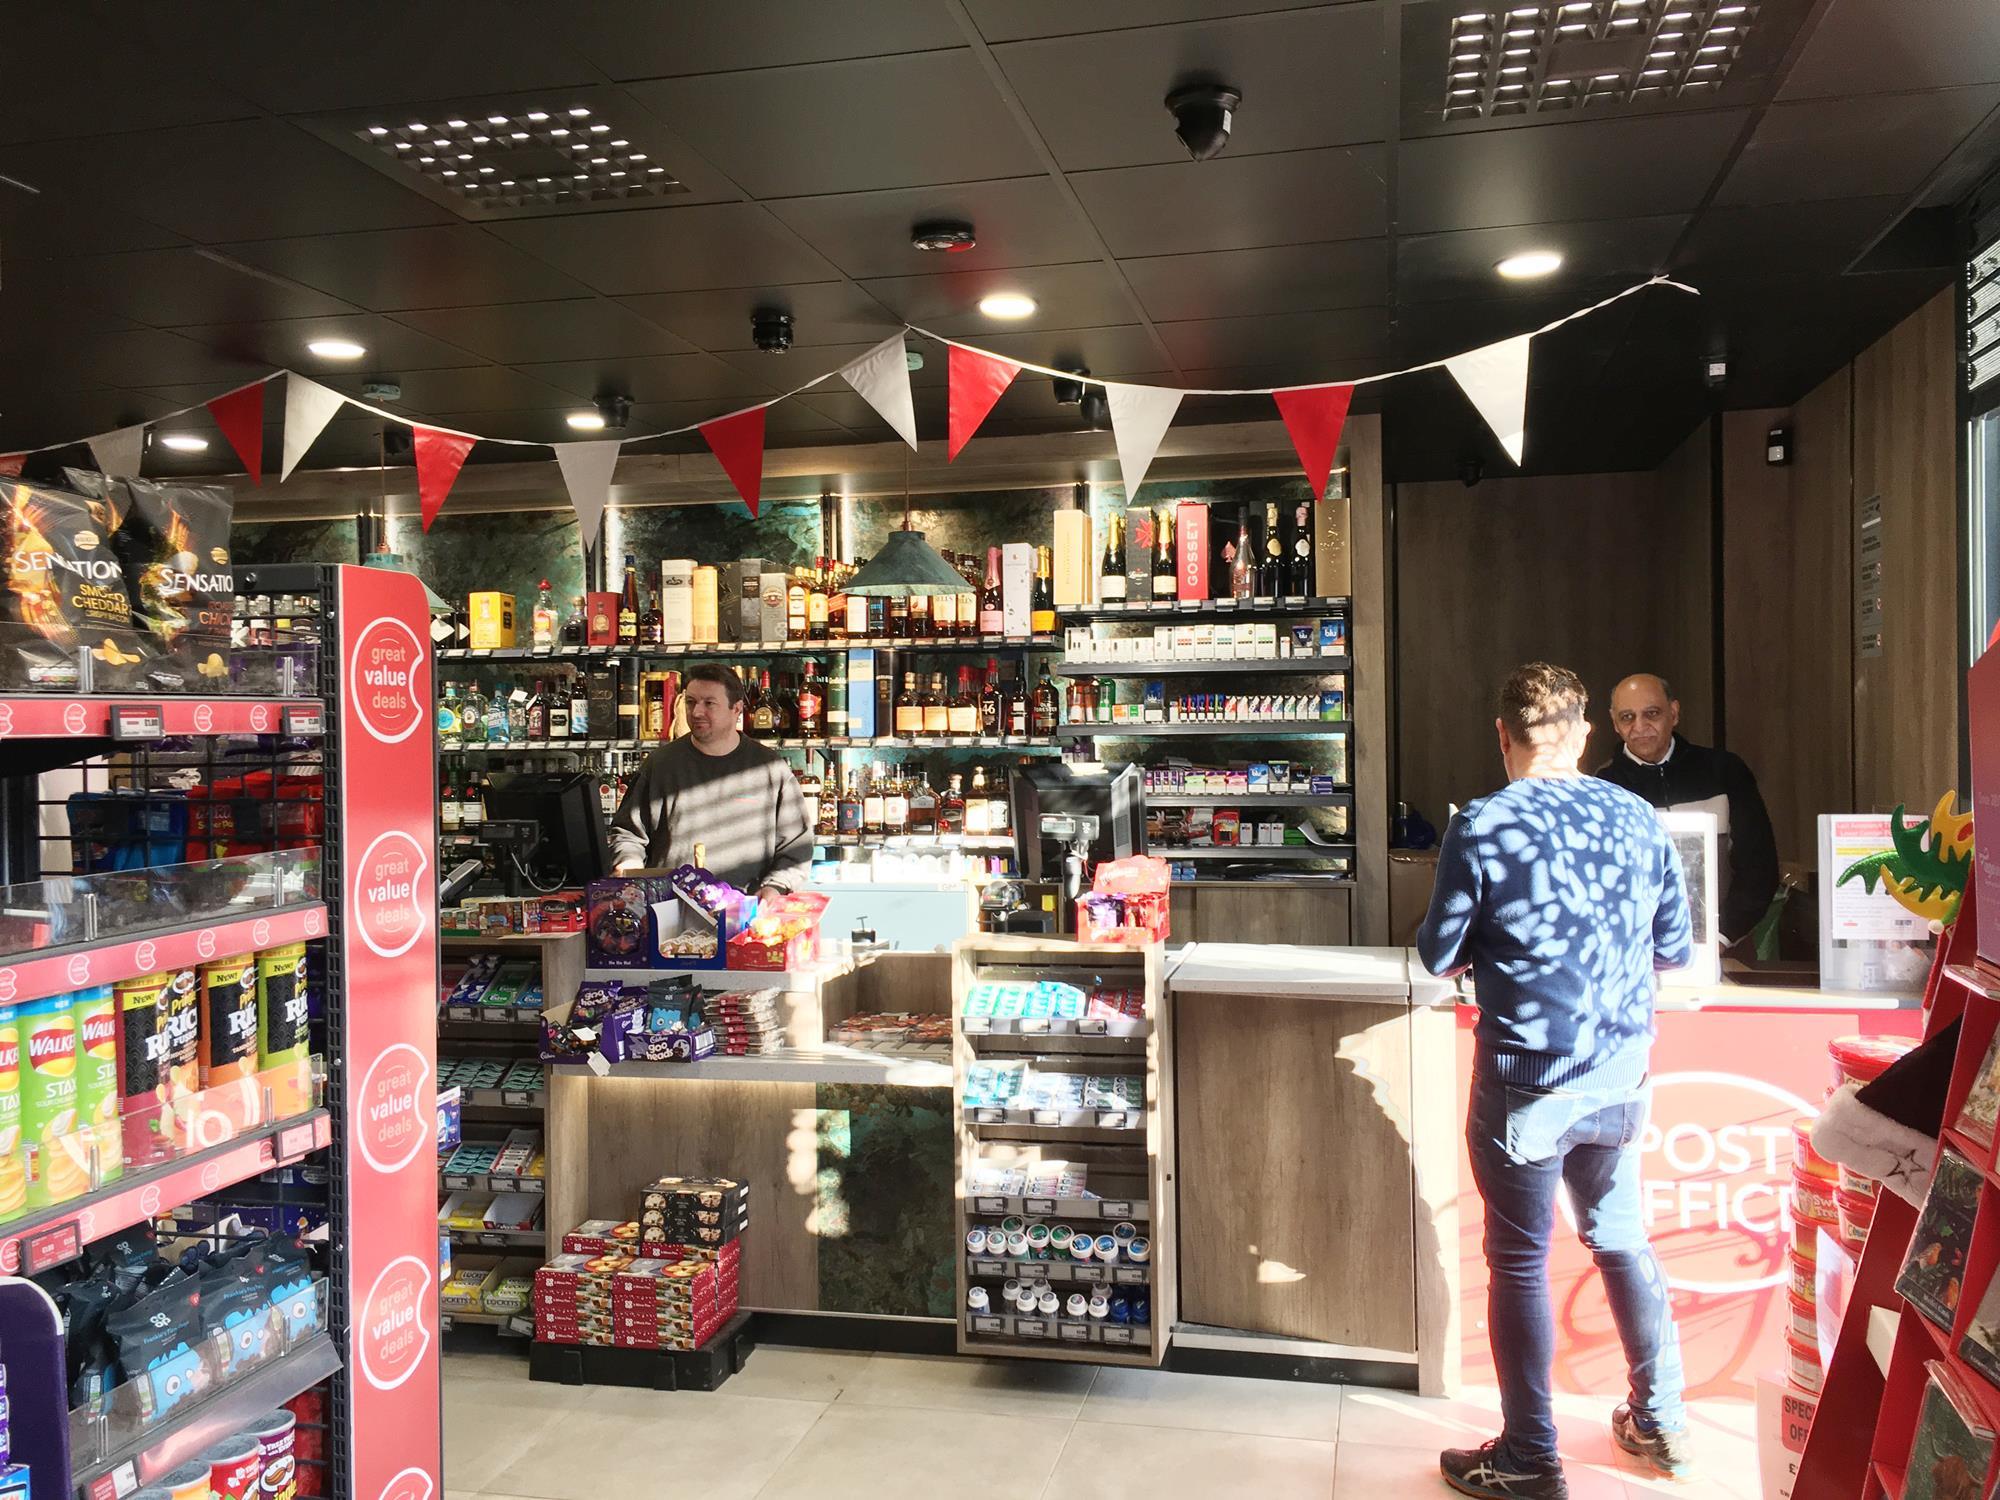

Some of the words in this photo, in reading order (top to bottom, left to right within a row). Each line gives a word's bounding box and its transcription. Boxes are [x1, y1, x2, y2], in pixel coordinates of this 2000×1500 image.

[1186, 520, 1198, 586] GOSSET
[371, 647, 406, 665] great
[364, 665, 408, 686] value
[372, 691, 407, 709] deals
[981, 703, 996, 715] 46
[375, 857, 409, 881] great
[368, 879, 410, 903] value
[375, 903, 410, 925] deals
[646, 1048, 674, 1060] heads
[648, 1041, 668, 1054] goo
[377, 1069, 412, 1099] great
[370, 1093, 412, 1122] value
[378, 1115, 412, 1142] deals
[1641, 1122, 1792, 1175] POST
[1643, 1179, 1792, 1233] FFIC
[379, 1280, 414, 1316] great
[372, 1305, 414, 1341] value
[379, 1328, 415, 1360] deals
